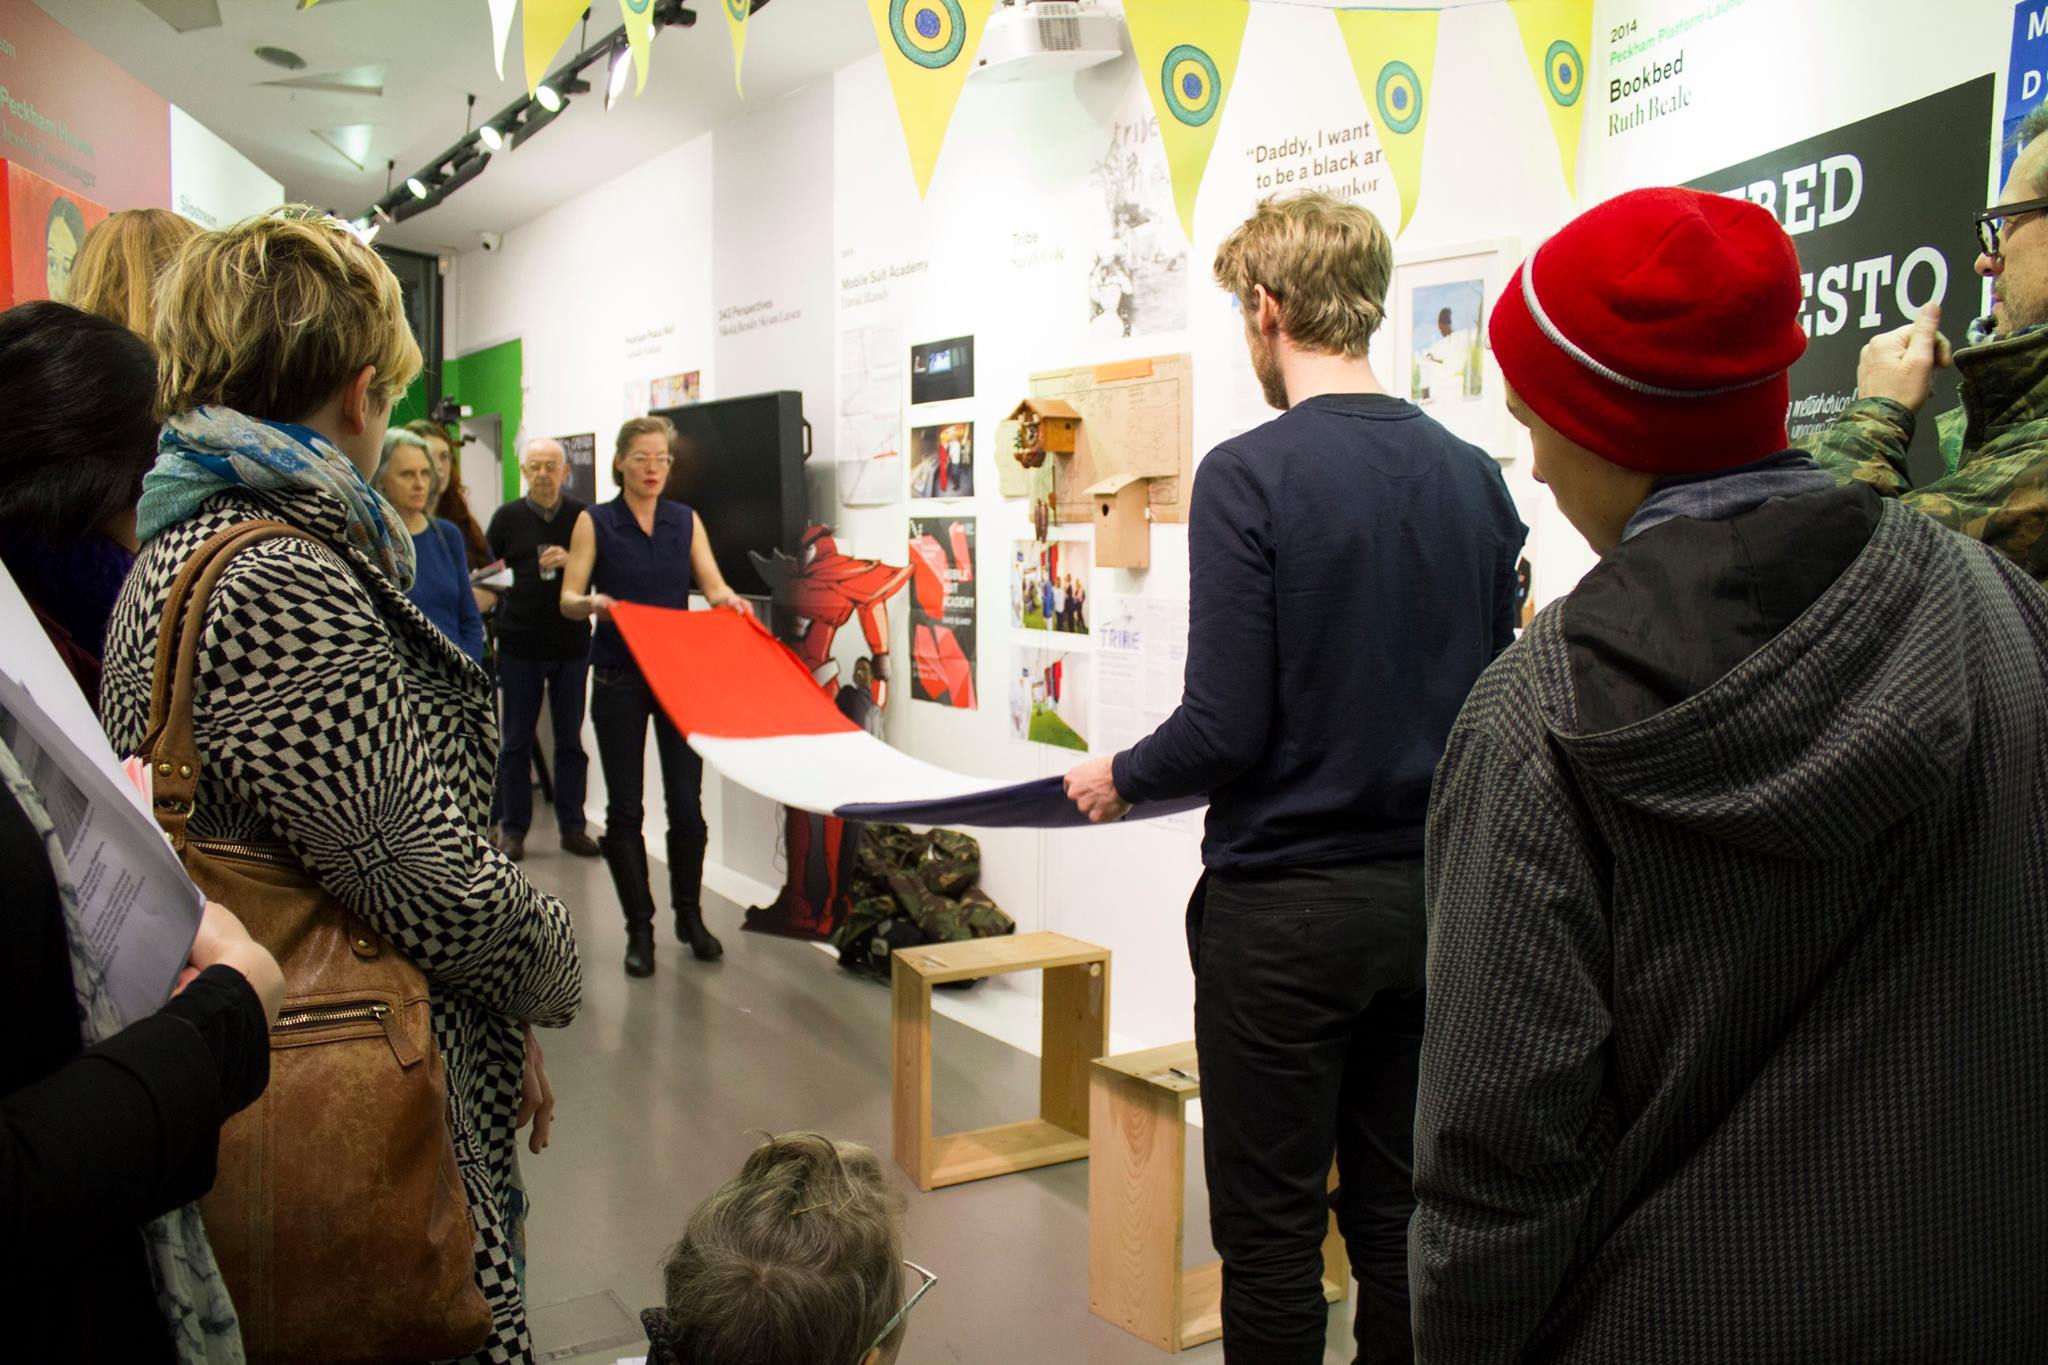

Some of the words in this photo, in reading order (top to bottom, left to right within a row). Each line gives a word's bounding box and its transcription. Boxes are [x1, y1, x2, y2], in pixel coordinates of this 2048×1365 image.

[1610, 36, 1656, 66] Peckham
[1611, 19, 1637, 43] 2014
[1611, 49, 1683, 103] Bookbed
[1609, 103, 1644, 137] Ruth
[1649, 85, 1692, 121] Beale
[1318, 129, 1322, 148] I
[1327, 121, 1370, 146] want
[1256, 174, 1271, 190] to
[1275, 167, 1295, 186] be
[1299, 166, 1308, 180] a
[1313, 150, 1359, 176] black
[1719, 154, 1863, 236] RED
